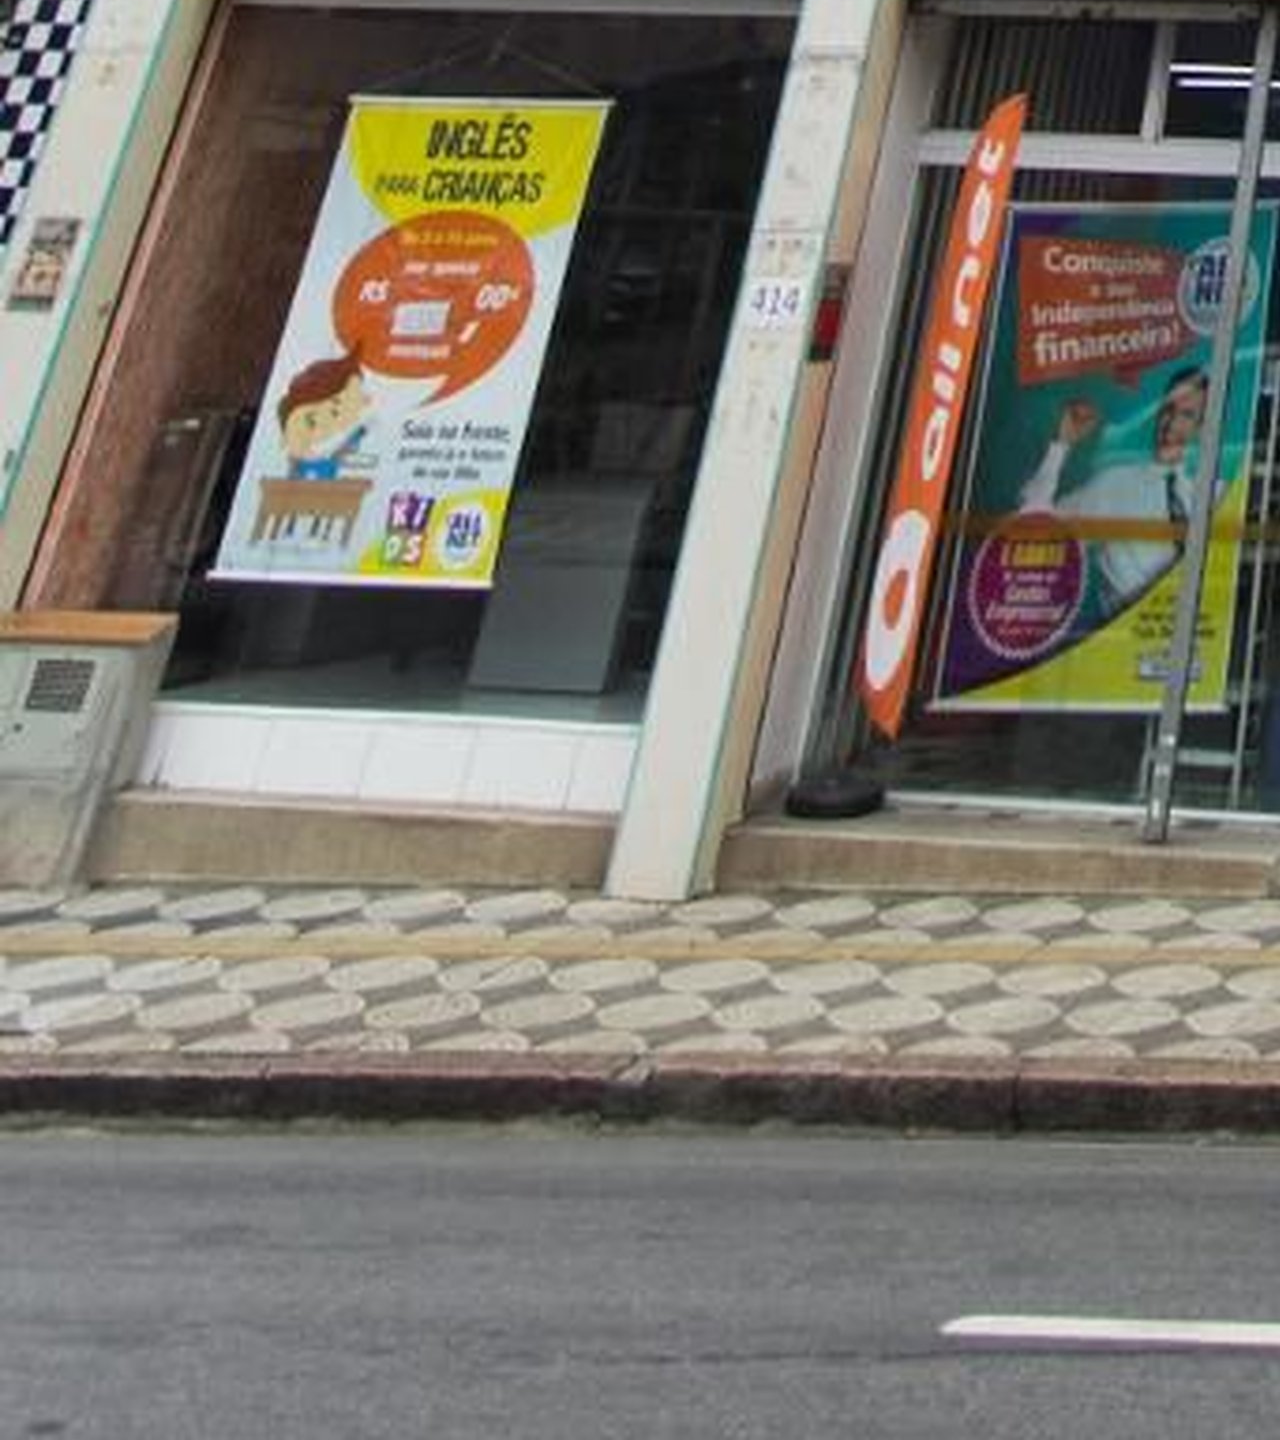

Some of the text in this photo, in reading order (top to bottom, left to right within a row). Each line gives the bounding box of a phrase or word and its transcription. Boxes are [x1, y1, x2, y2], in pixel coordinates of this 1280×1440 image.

[426, 113, 533, 160] INGLÊS
[422, 169, 545, 209] CRIANÇAS
[1043, 246, 1167, 275] Conquiste
[1033, 319, 1181, 365] financeira!
